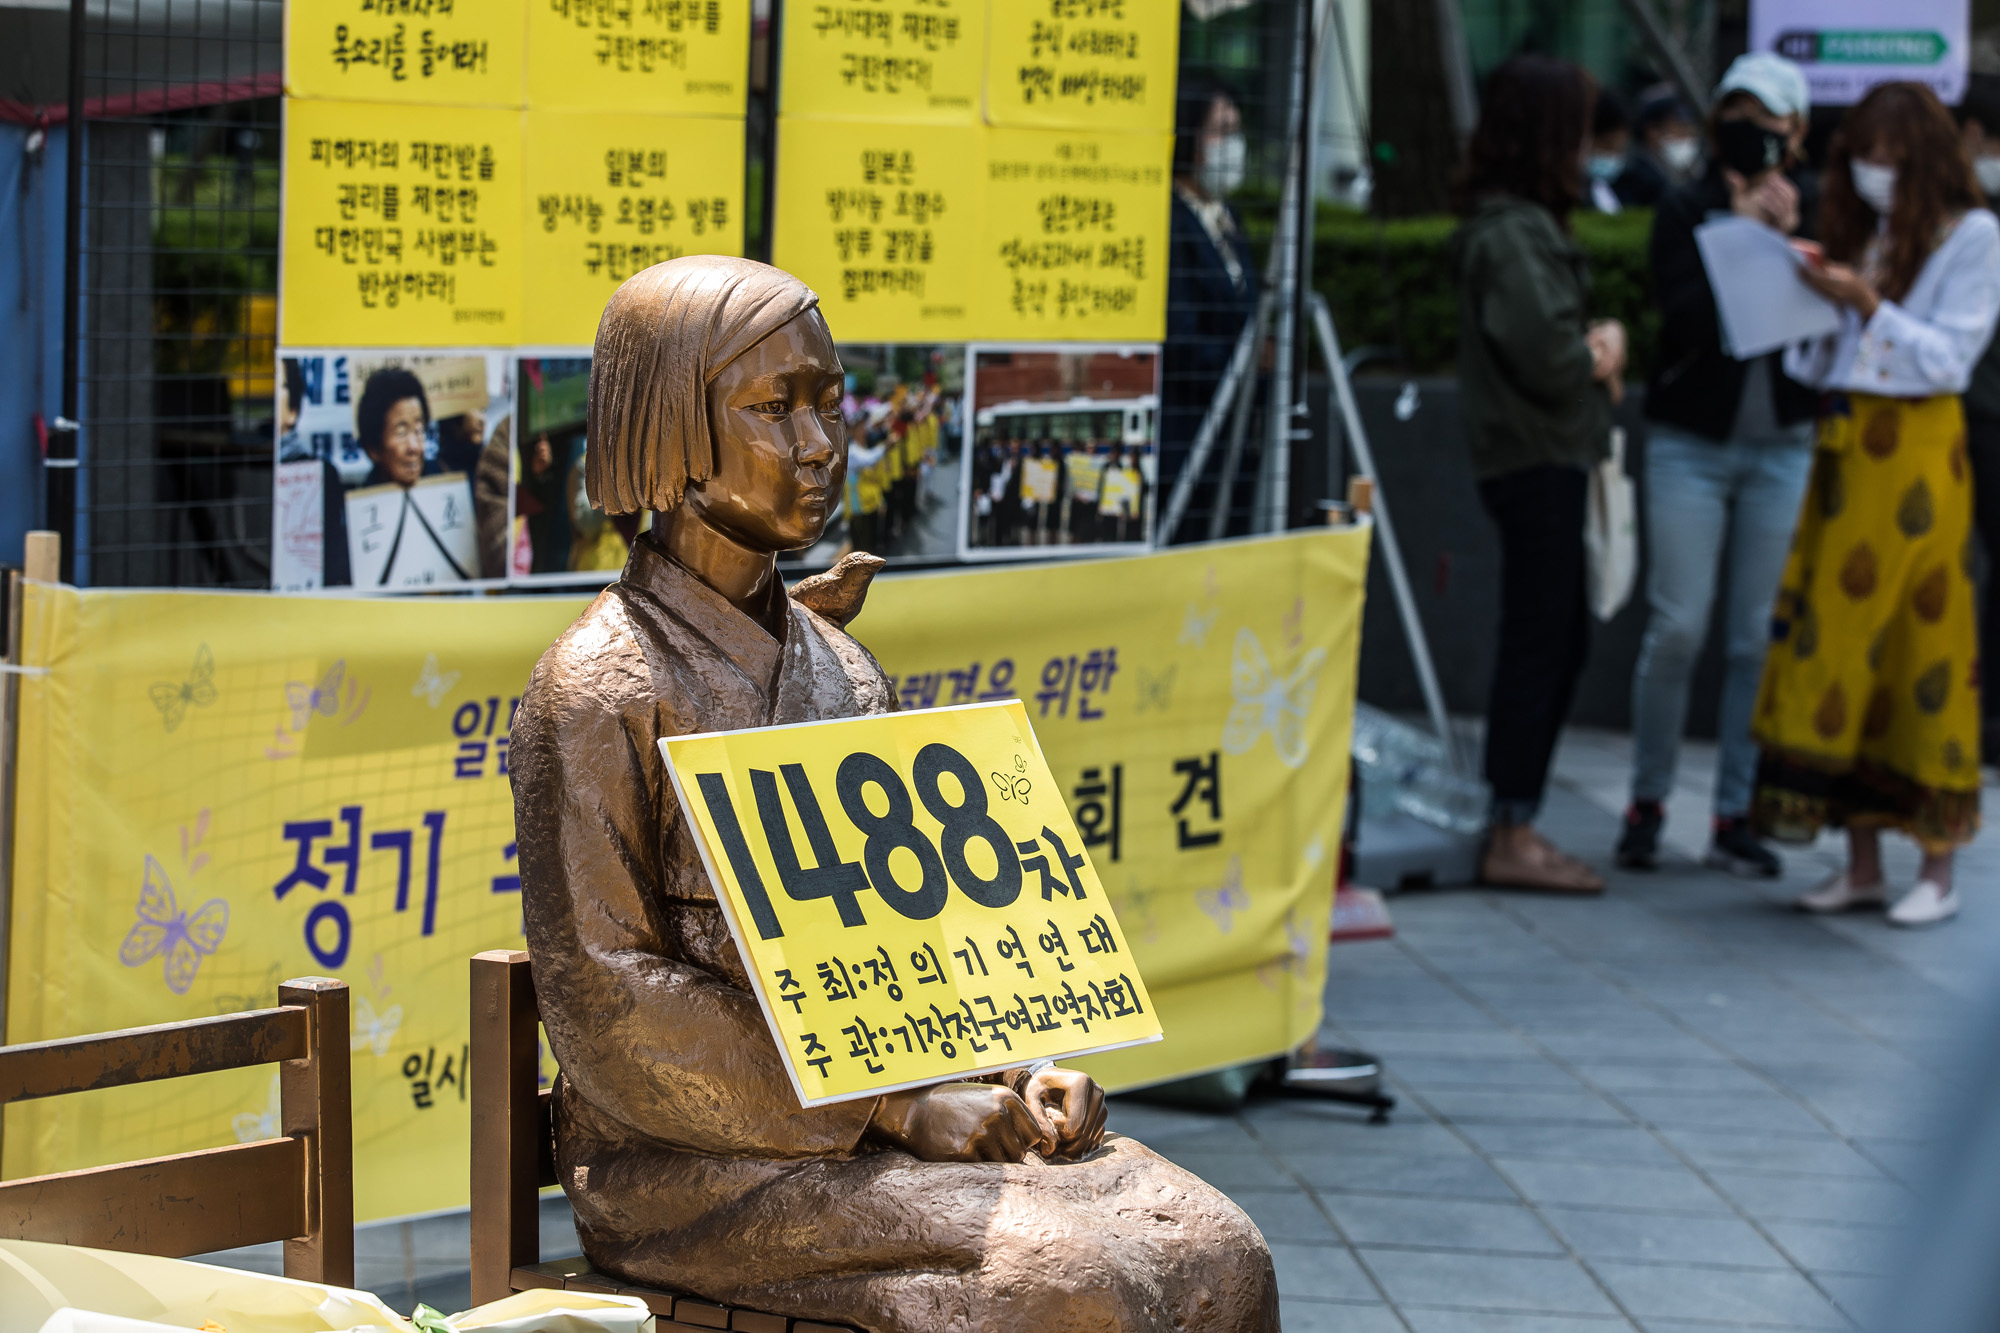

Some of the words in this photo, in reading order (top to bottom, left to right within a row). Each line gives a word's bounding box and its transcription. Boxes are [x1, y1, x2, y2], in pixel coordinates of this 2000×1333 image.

[331, 22, 407, 82] 목소리를
[310, 138, 399, 169] 피해자의
[409, 141, 496, 182] 재판받을
[605, 149, 667, 189] 일본의
[337, 183, 400, 222] 권리를
[411, 185, 479, 224] 제한한
[537, 195, 605, 235] 방사능
[616, 196, 676, 235] 오염수
[314, 225, 403, 265] 대한민국
[414, 229, 498, 268] 사법부는
[357, 271, 456, 309] 반성하라!
[1034, 647, 1119, 722] 위한
[1169, 750, 1224, 852] 견
[694, 742, 1086, 941] 1488차
[272, 805, 447, 971] 정기
[401, 1044, 470, 1111] 일시
